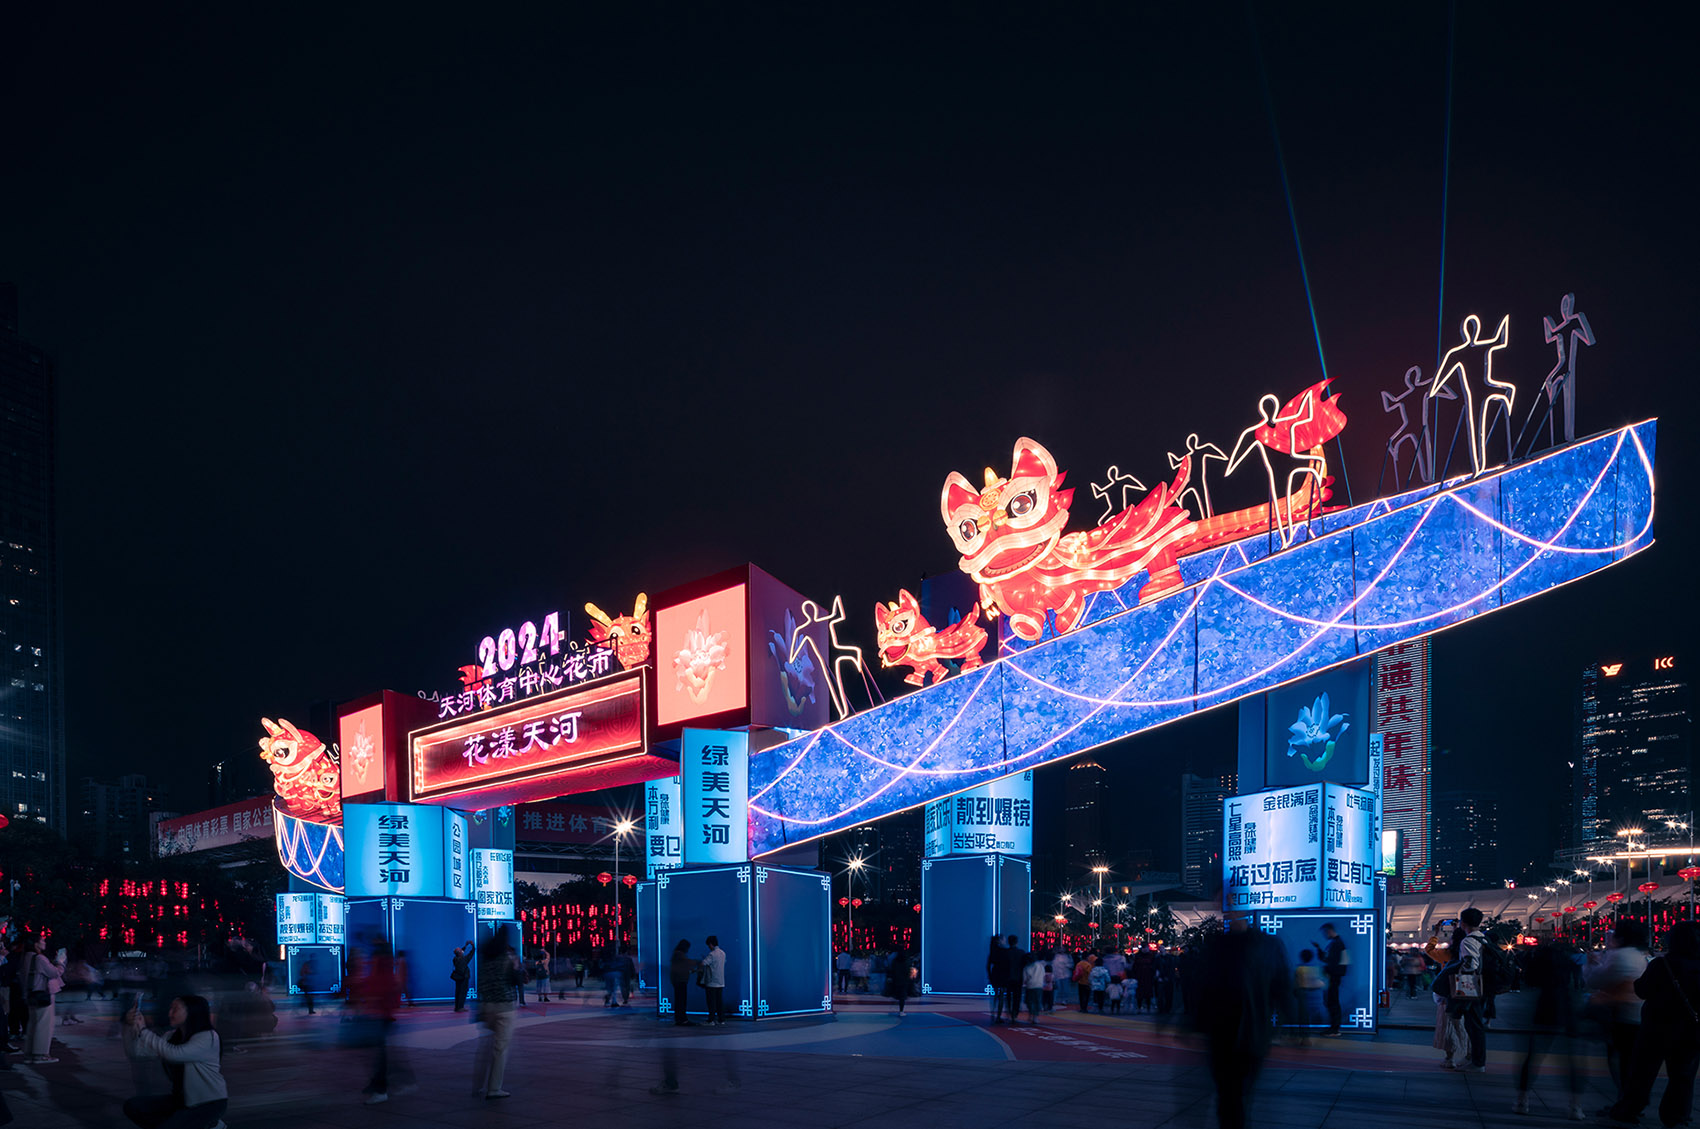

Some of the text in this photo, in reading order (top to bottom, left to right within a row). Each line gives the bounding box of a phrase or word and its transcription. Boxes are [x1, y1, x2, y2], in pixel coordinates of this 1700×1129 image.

[479, 611, 567, 679] 2024
[1654, 656, 1674, 670] ICC
[438, 647, 614, 718] 天河体育中心花市
[462, 711, 583, 768] 花漾天河
[701, 744, 730, 845] 绿美天河
[956, 796, 1031, 827] 靓到爆镜
[1263, 789, 1319, 812] 金银满屋
[178, 805, 273, 841] 中国体育彩票 国家公益
[522, 810, 645, 836] 推进体育
[953, 832, 996, 850] 岁岁平安
[1228, 802, 1242, 861] 七星高照
[378, 814, 411, 884] 绿美天河
[1229, 857, 1317, 888] 掂过碌蔗
